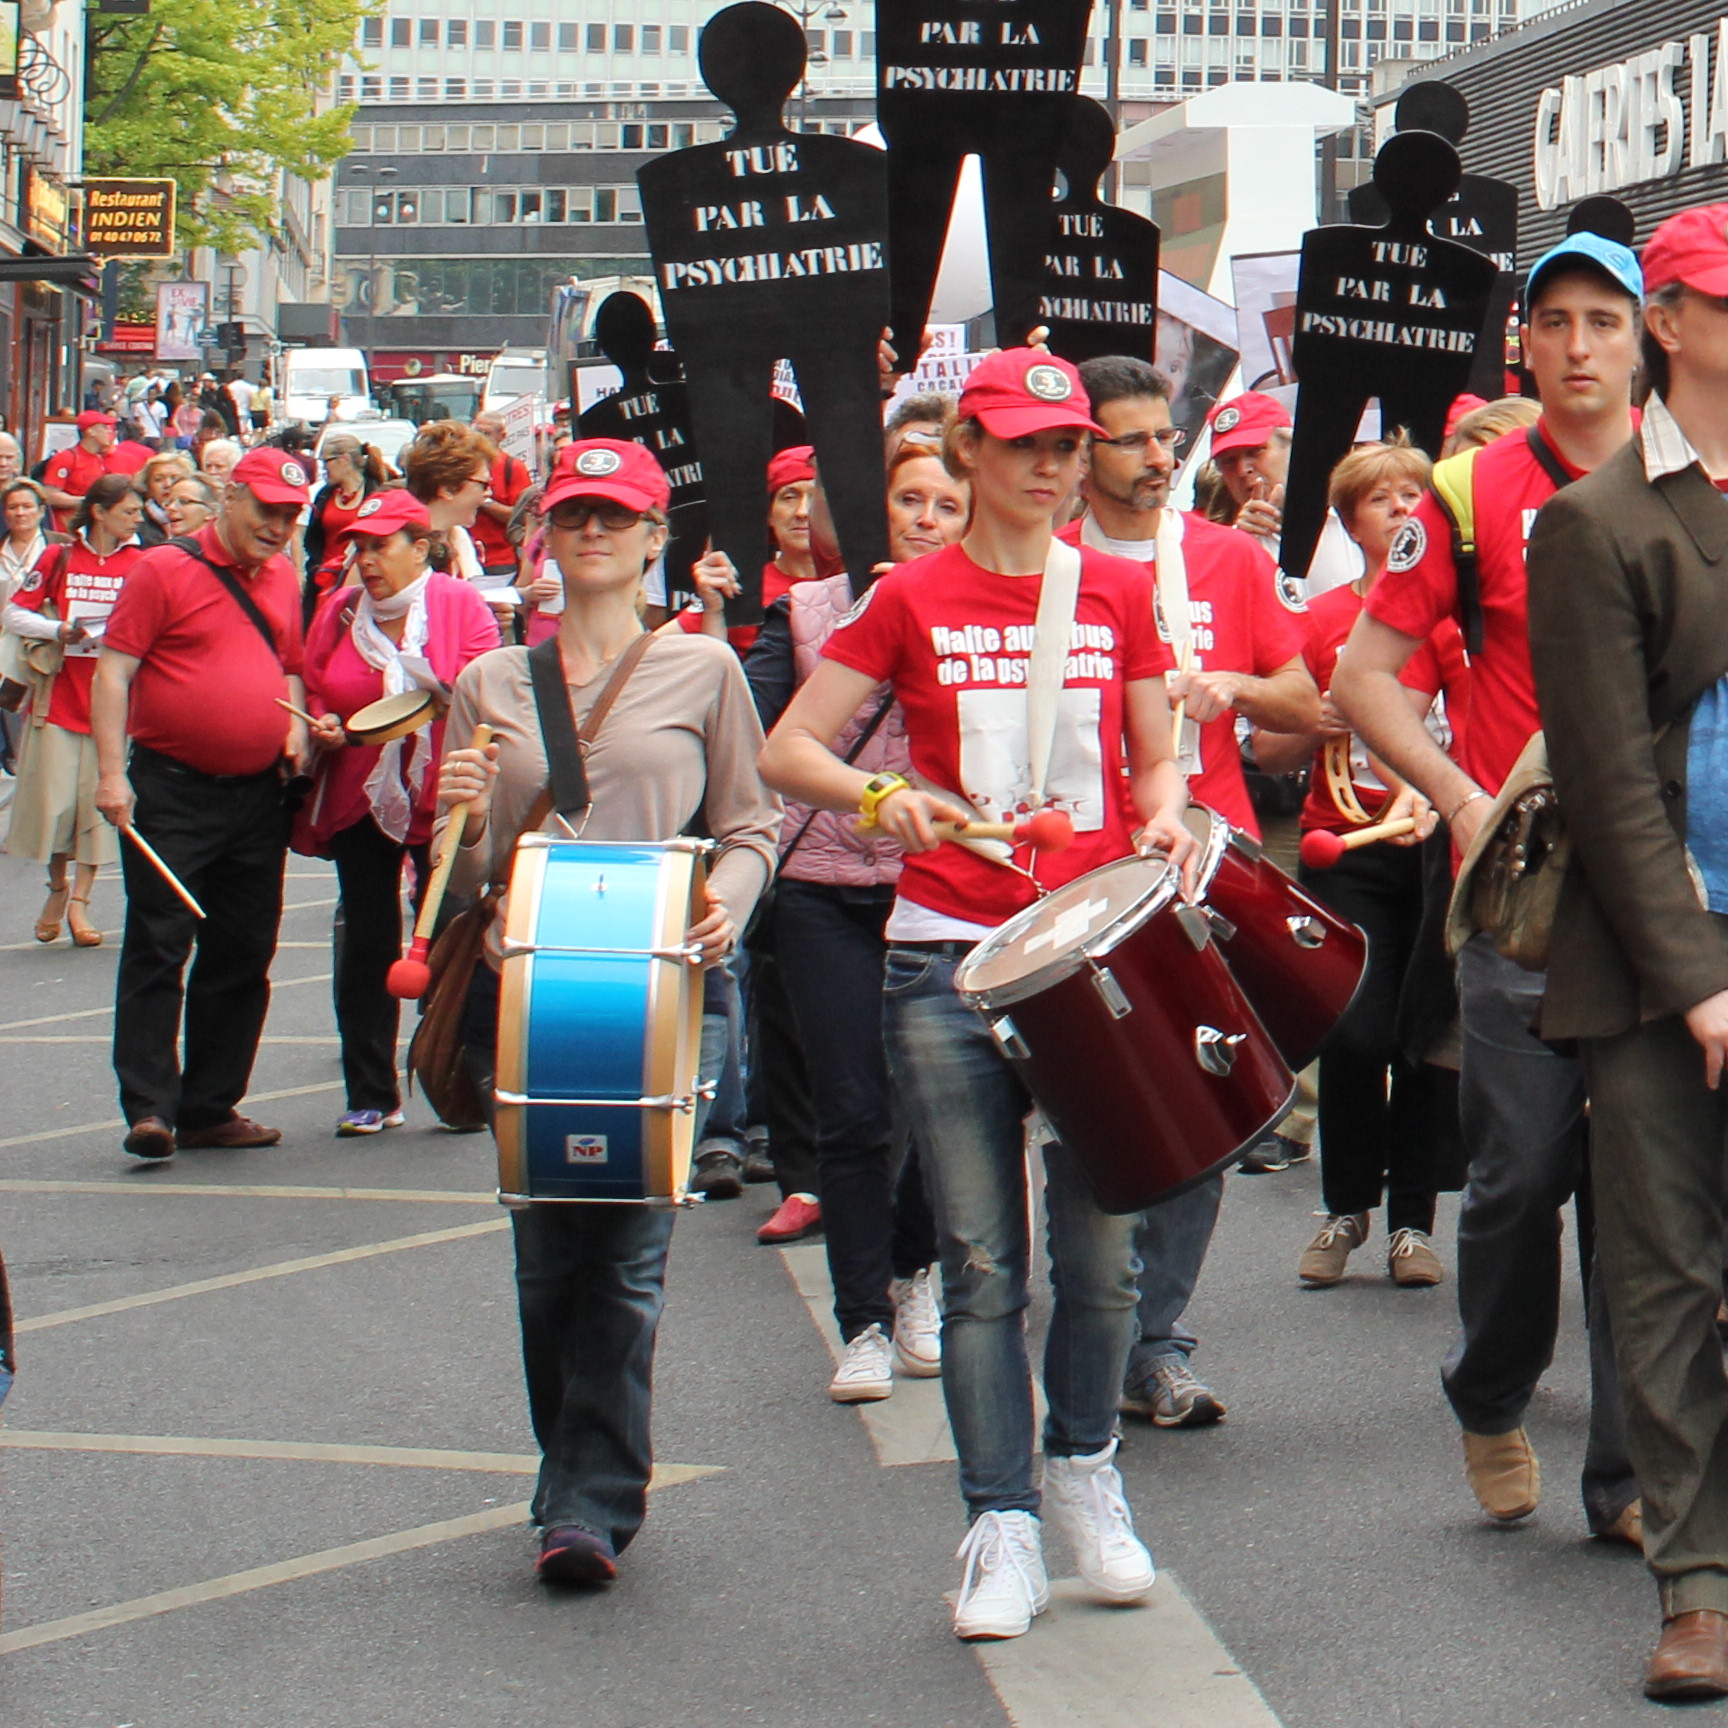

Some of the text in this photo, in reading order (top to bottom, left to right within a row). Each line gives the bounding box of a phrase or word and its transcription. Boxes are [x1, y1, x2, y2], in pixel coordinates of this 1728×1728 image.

[919, 20, 1041, 45] PAR LA
[884, 65, 1076, 92] PSYCHIATRIE
[1533, 41, 1685, 211] GALERIES
[725, 140, 799, 177] TUÉ
[89, 191, 165, 208] Restaurant
[693, 194, 836, 232] PAR LA
[90, 211, 162, 227] INDIEN
[1058, 212, 1104, 238] TUÉ
[1449, 216, 1484, 237] LA
[663, 241, 884, 290] PSYCHIATRIE
[1093, 255, 1125, 279] LA
[1371, 240, 1428, 269] TUÉ
[1335, 276, 1447, 310] PAR LA
[1040, 295, 1153, 326] YCHIATRIE
[1302, 311, 1476, 354] PSYCHIATRIE
[618, 391, 661, 421] TUÉ
[655, 427, 686, 450] LA
[930, 621, 1116, 657] Halte au bus
[937, 656, 969, 686] de
[970, 654, 996, 683] la
[572, 1144, 604, 1158] NP
